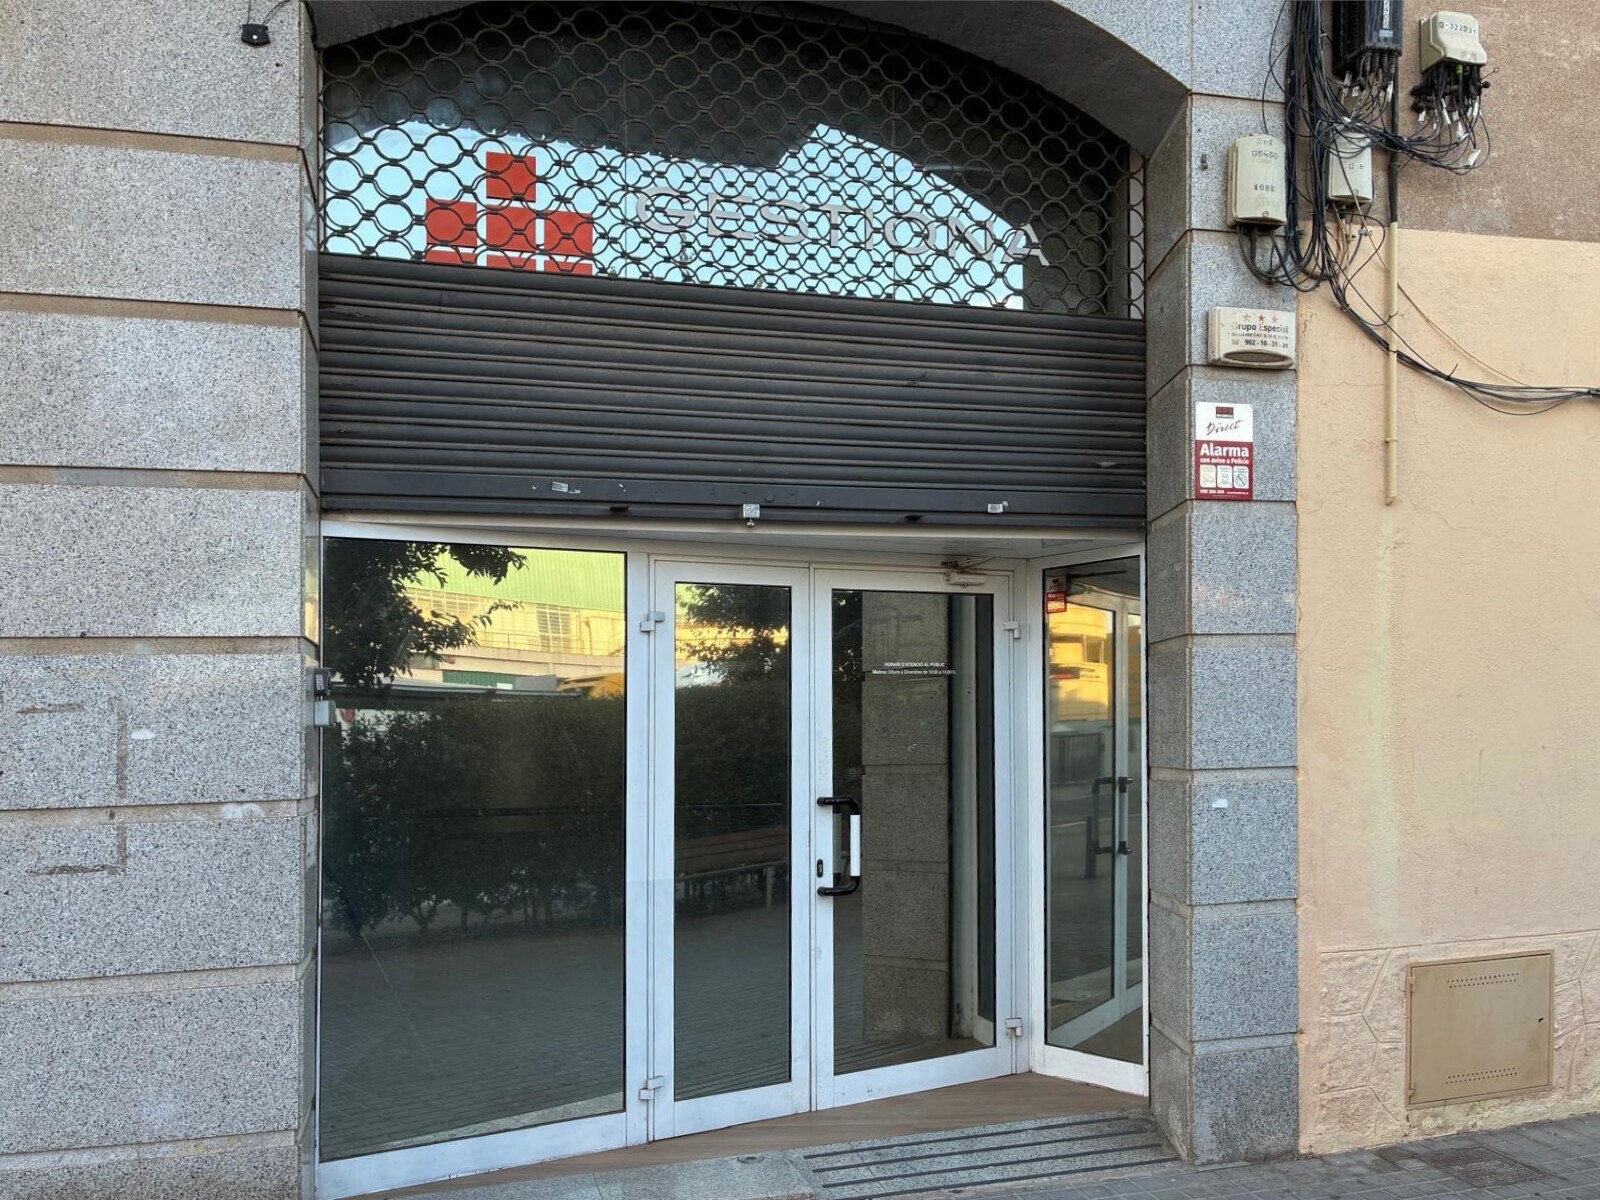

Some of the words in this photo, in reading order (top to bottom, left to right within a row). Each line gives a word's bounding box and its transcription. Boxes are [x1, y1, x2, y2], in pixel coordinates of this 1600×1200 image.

[635, 185, 1049, 266] GESTIONA
[1205, 420, 1246, 436] Direct
[1200, 442, 1249, 457] Alarma
